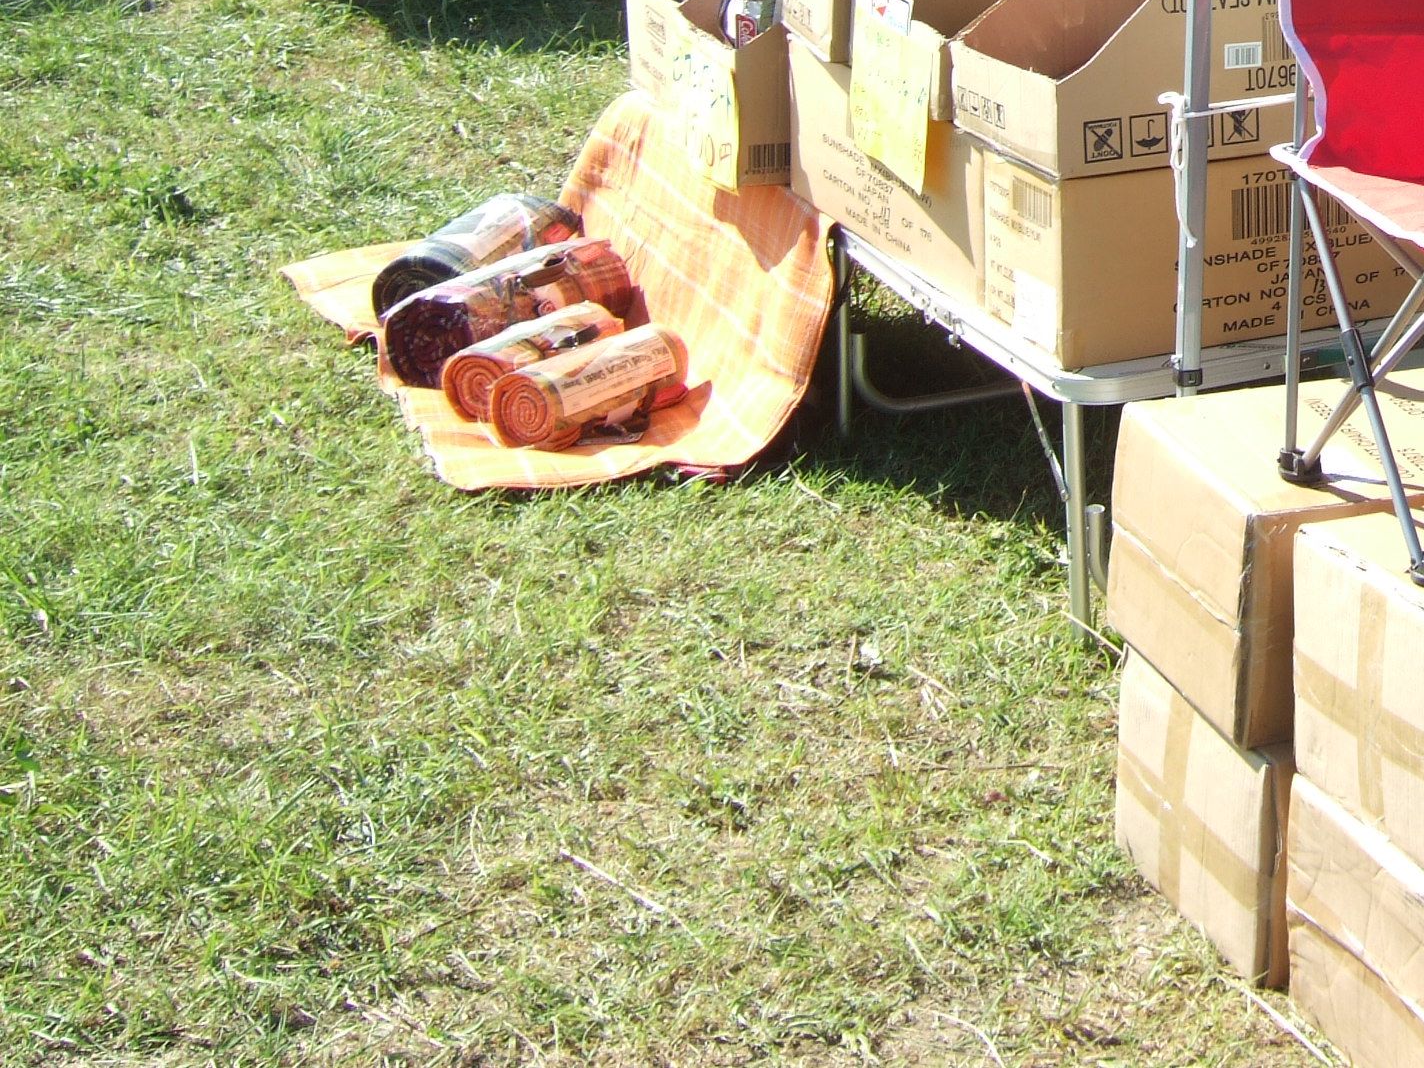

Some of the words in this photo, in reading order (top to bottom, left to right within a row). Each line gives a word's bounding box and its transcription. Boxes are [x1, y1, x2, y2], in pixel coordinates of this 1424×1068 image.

[822, 134, 865, 166] SUNSHADE
[823, 169, 855, 196] CARTON
[901, 217, 914, 229] OF
[863, 184, 890, 204] JAPAN
[845, 206, 869, 228] MADE
[885, 231, 912, 253] CHINA
[1271, 268, 1326, 285] JAAN
[1355, 271, 1379, 284] OF
[1272, 301, 1282, 311] 4
[1223, 314, 1275, 333] MADE
